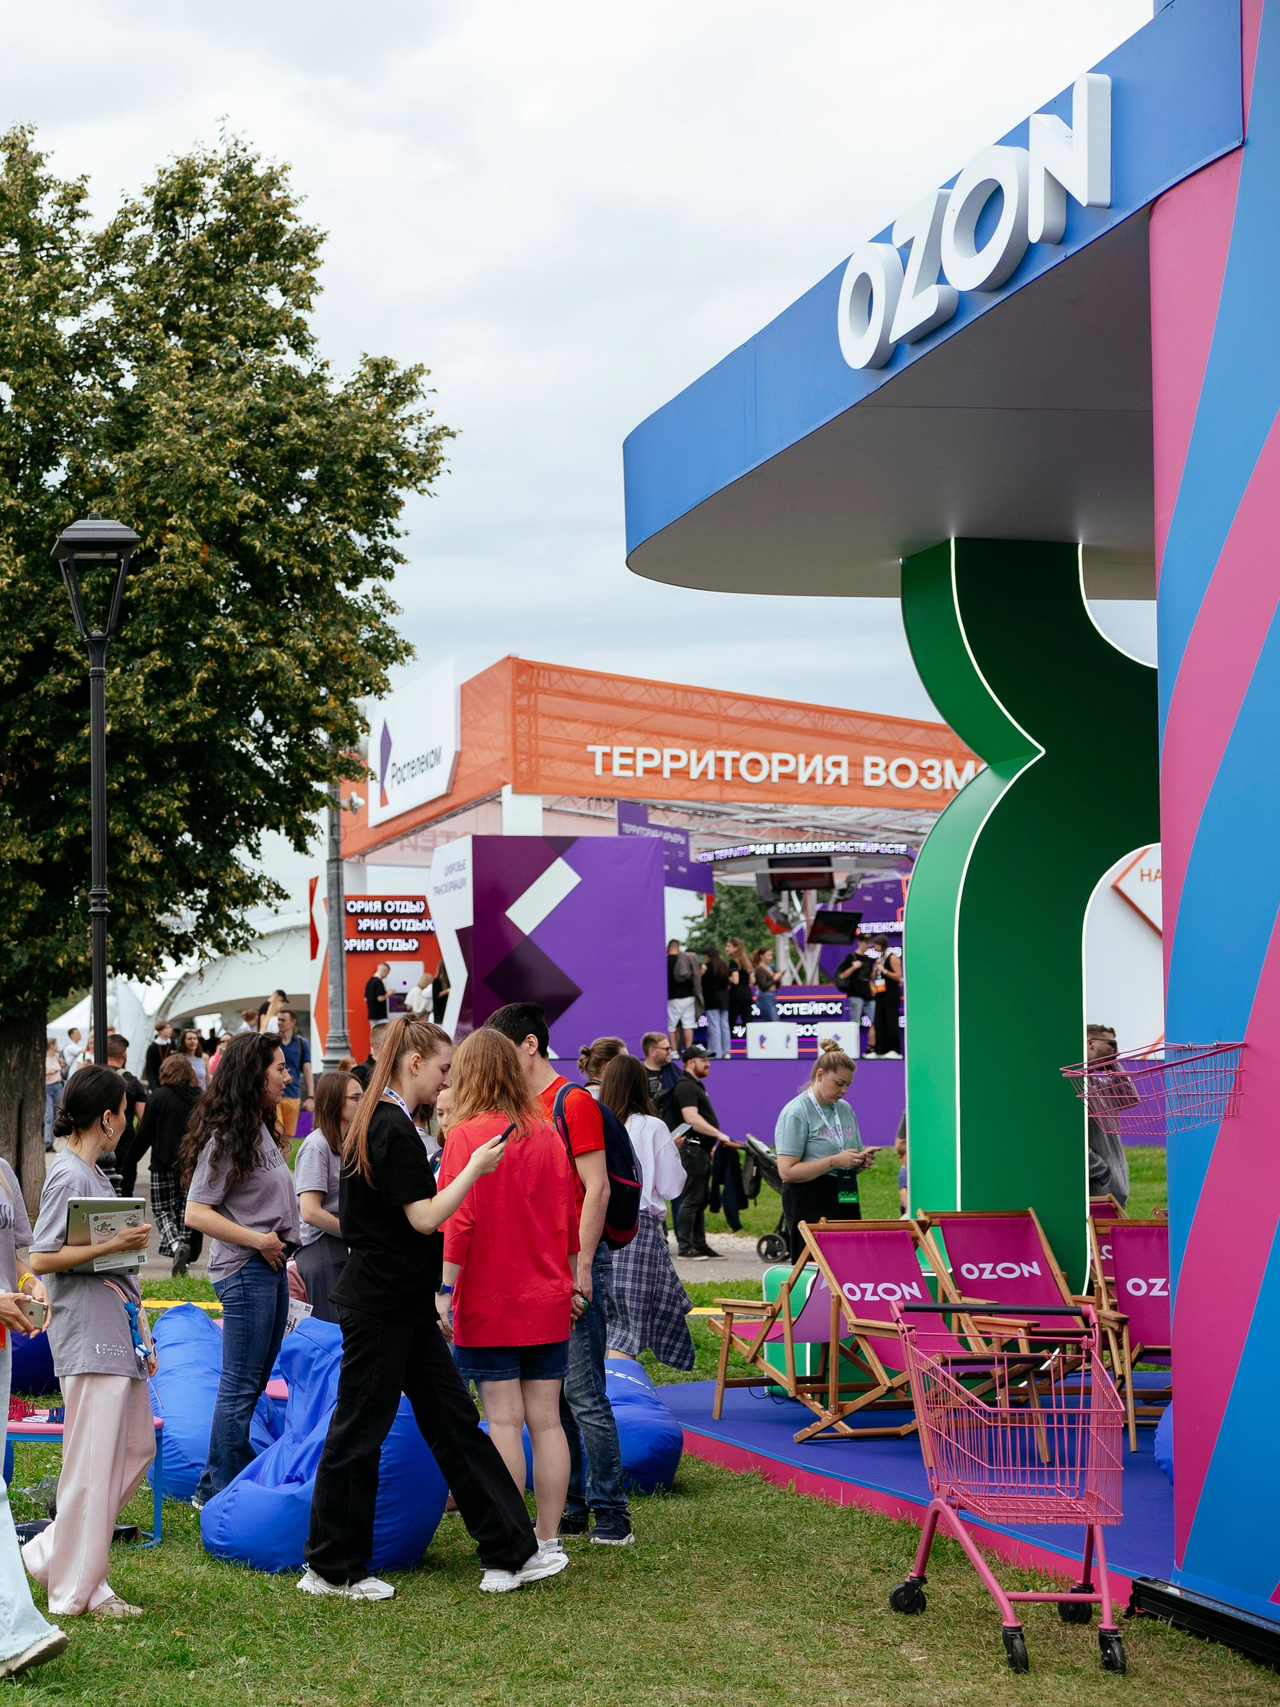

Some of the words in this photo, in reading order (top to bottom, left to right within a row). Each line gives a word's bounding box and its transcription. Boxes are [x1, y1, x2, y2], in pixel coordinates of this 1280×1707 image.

[838, 73, 1111, 369] OZON
[391, 747, 441, 788] Ростелеком
[587, 745, 849, 786] ТЕРРИТОРИЯ
[863, 756, 984, 791] ВОЗМ
[960, 1261, 1042, 1280] OZON
[842, 1281, 922, 1301] OZON
[1126, 1278, 1170, 1296] OZ
